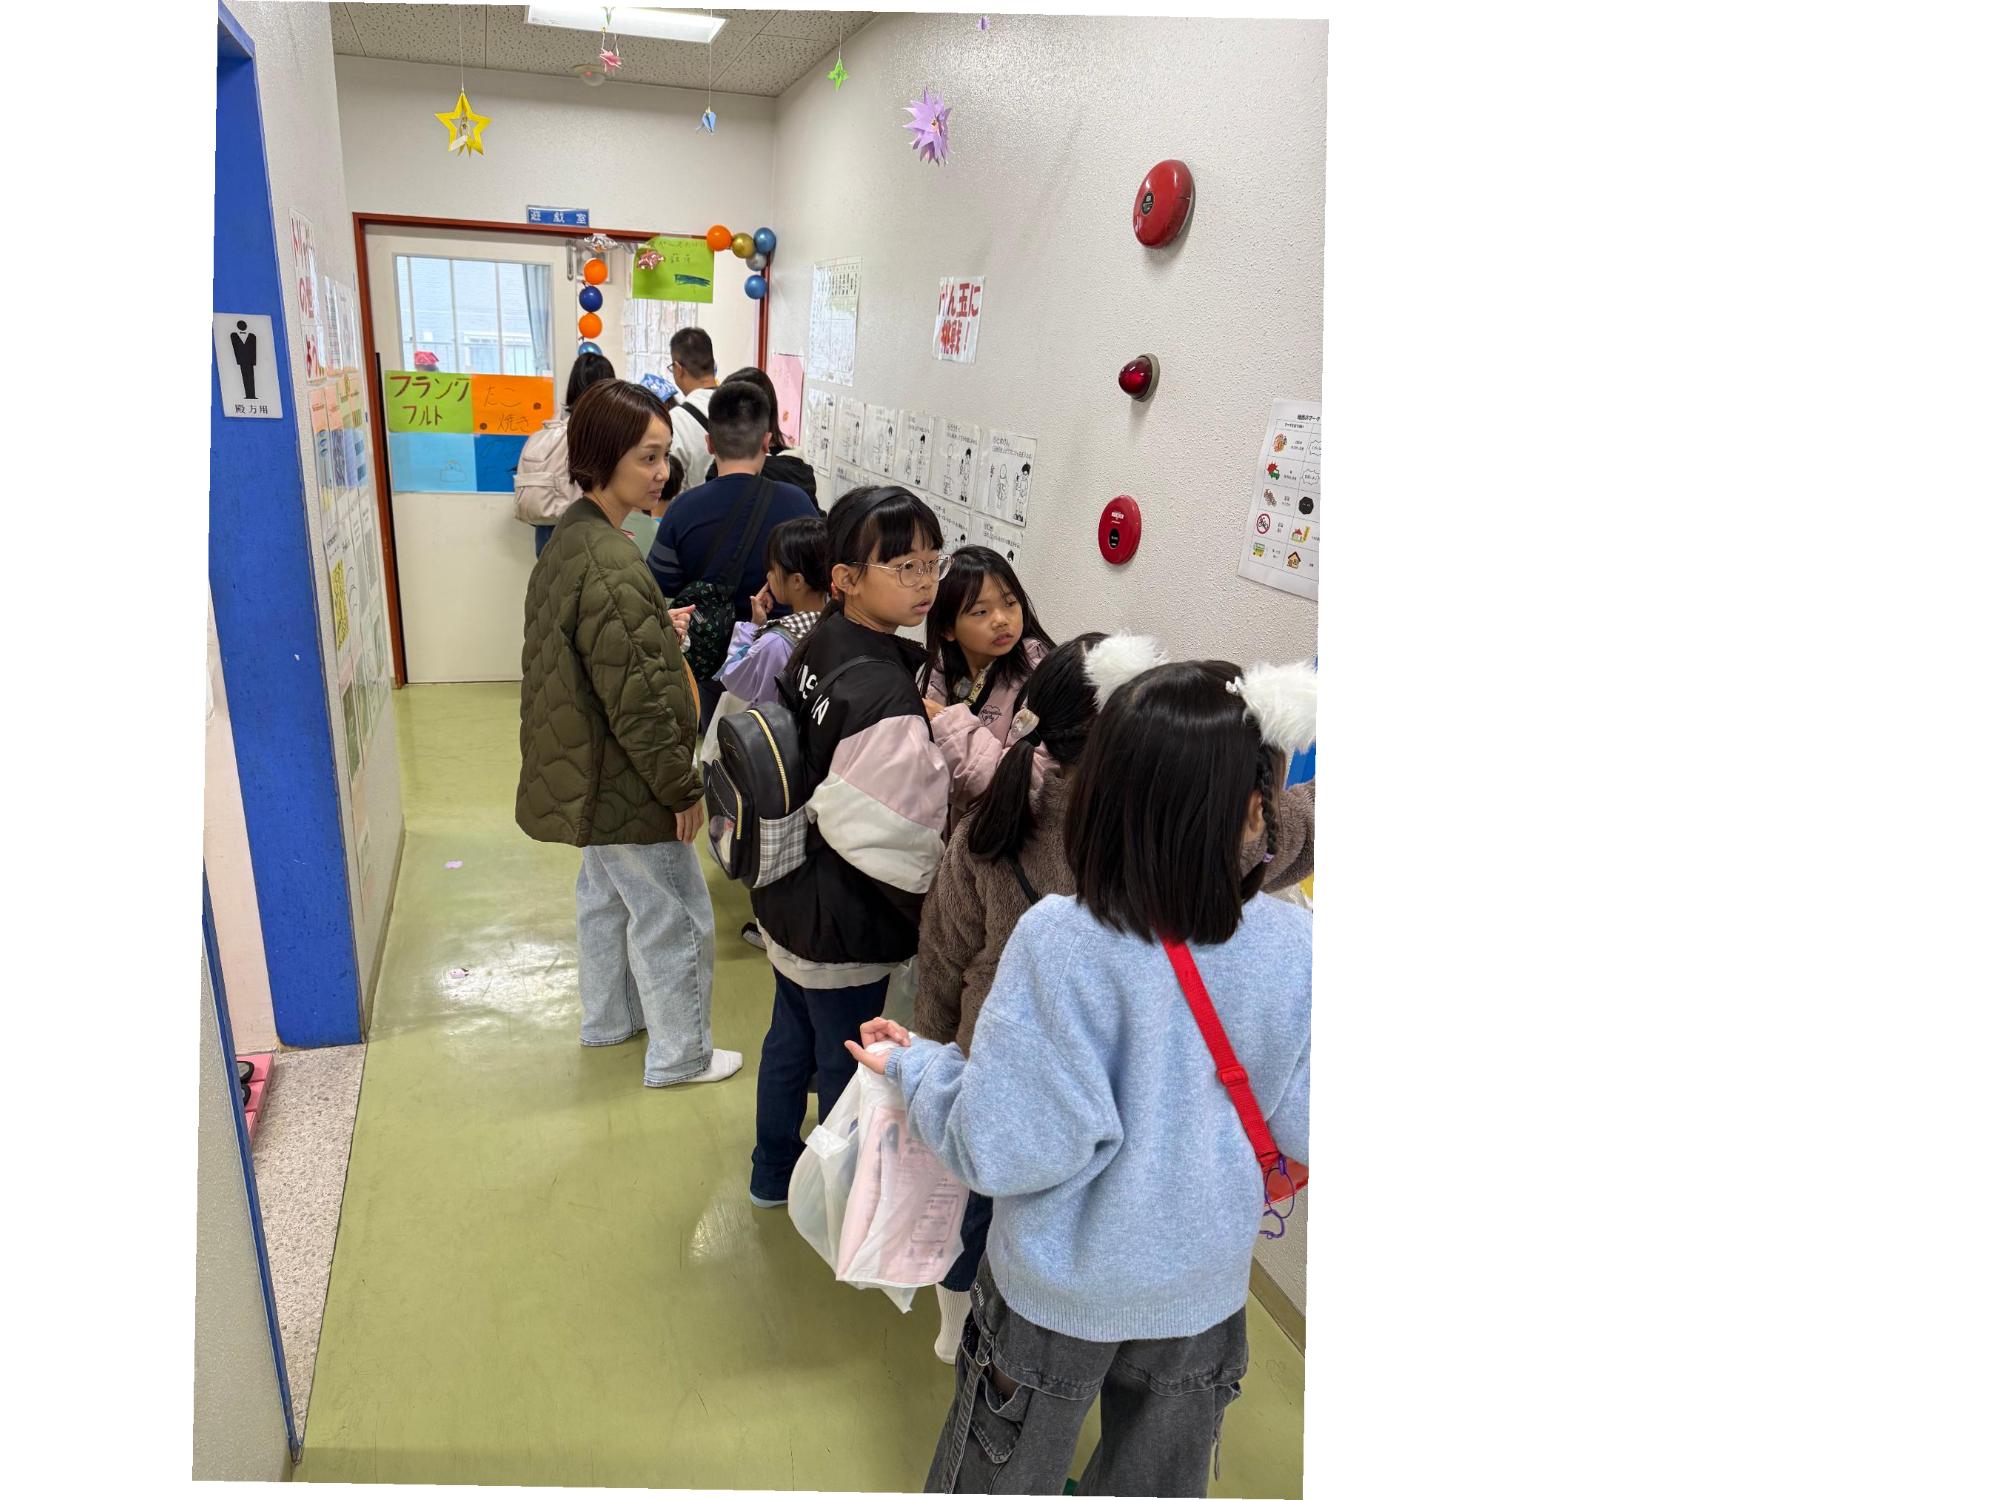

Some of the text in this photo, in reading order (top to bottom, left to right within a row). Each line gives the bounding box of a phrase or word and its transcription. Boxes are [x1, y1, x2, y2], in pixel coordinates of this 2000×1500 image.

[529, 209, 587, 224] 遊戯室
[235, 403, 268, 415] 殿方用
[401, 404, 443, 426] フルト
